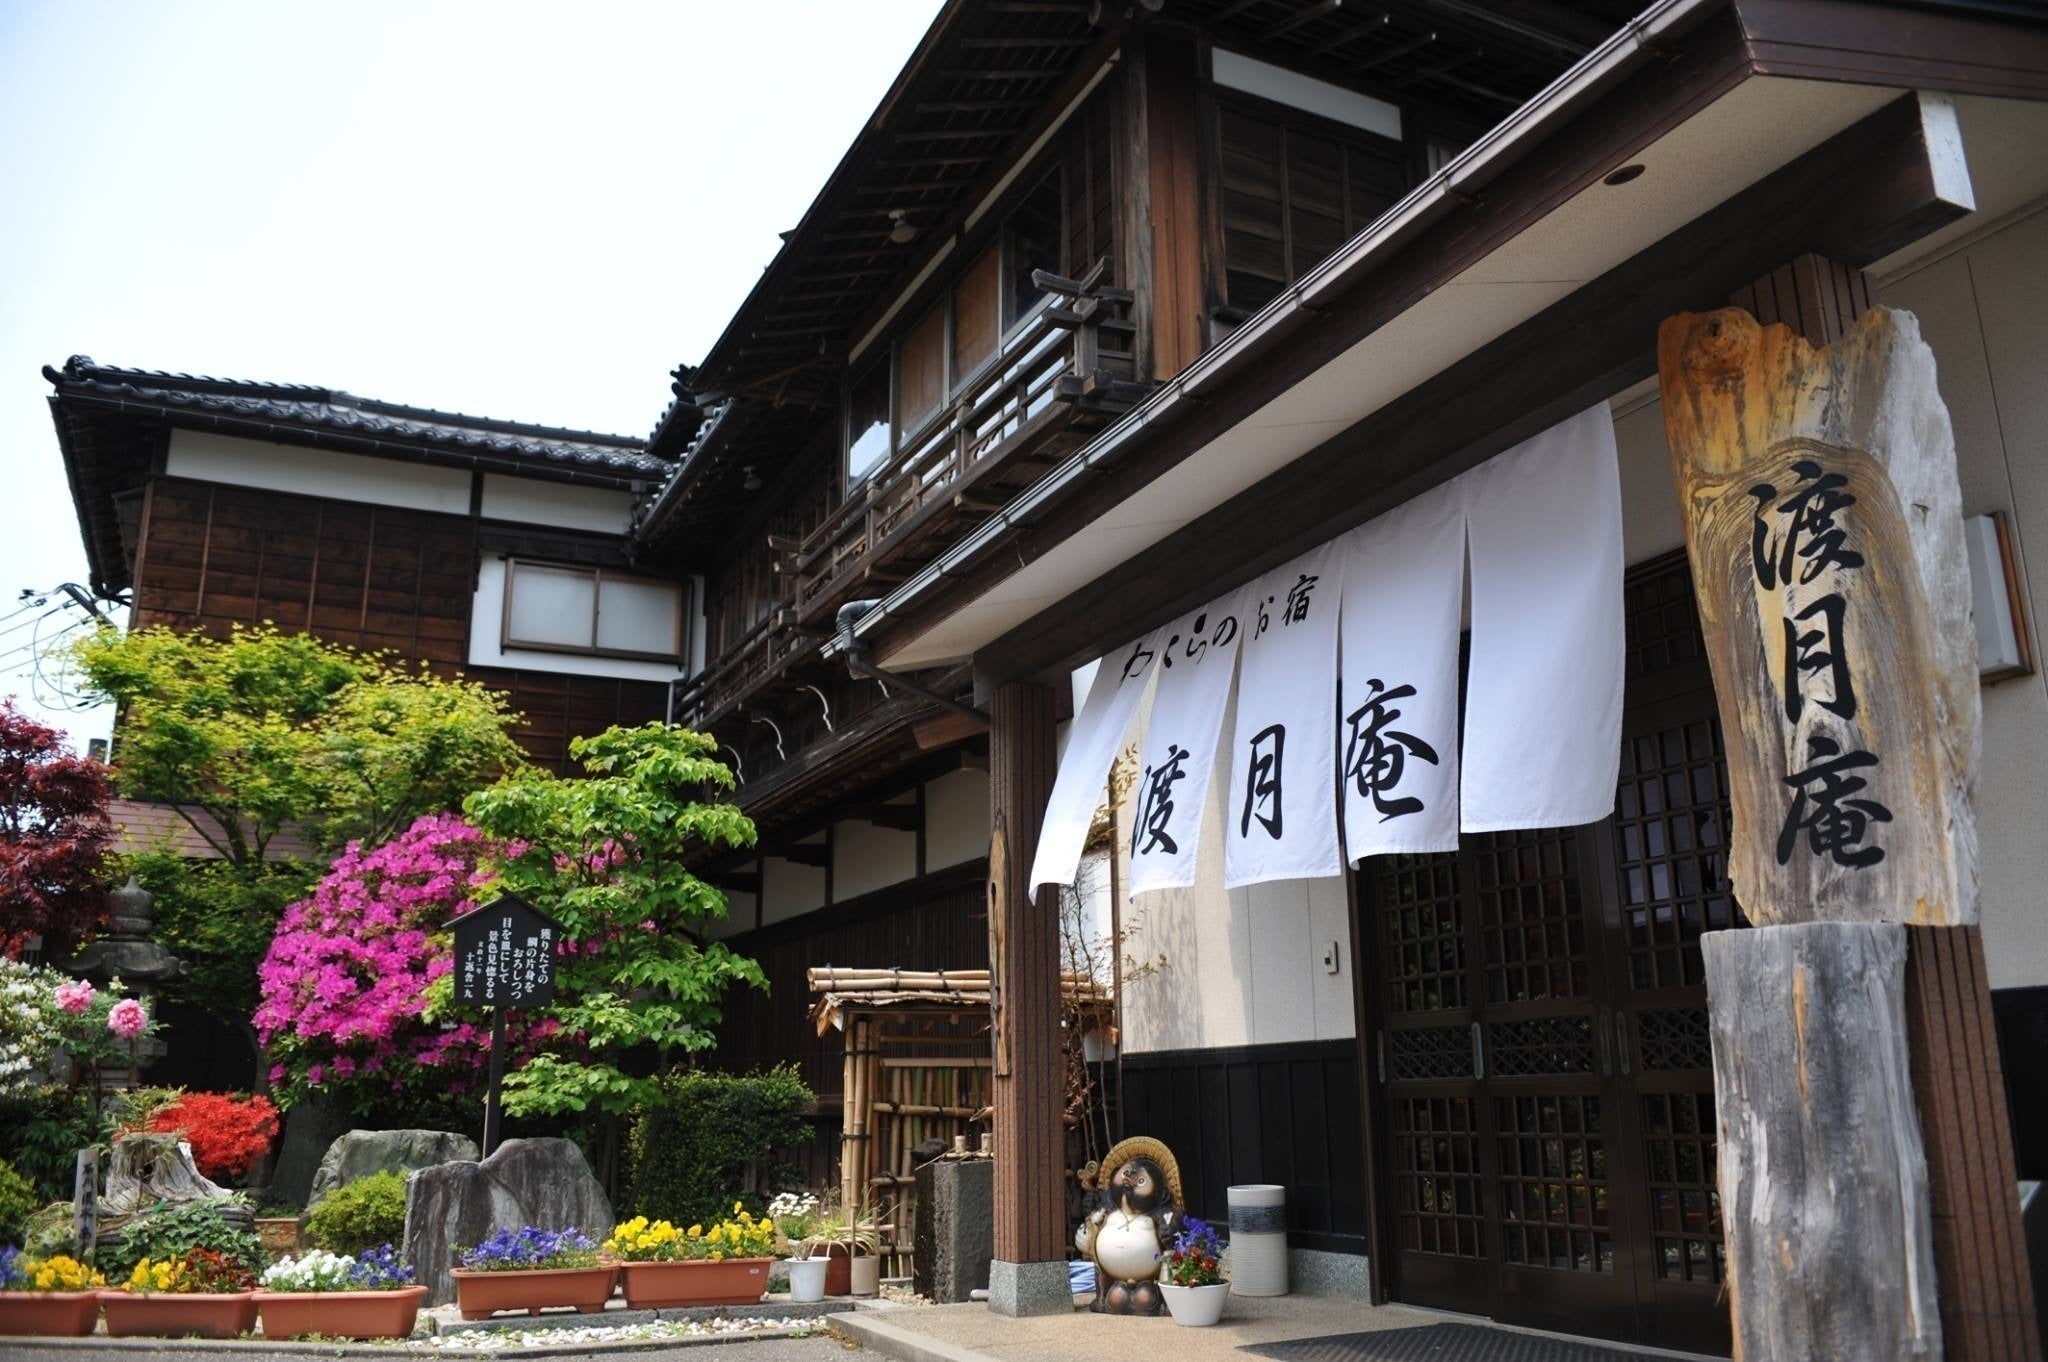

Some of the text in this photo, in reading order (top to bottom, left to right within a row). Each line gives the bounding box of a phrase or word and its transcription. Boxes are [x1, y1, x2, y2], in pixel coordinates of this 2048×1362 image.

[1119, 573, 1319, 686] わくらのお宿
[1747, 461, 1893, 870] 渡月庵
[1131, 678, 1439, 860] 渡月庵
[463, 951, 475, 998] 十返舎一九
[498, 917, 512, 984] 目を皿にして
[510, 948, 524, 999] おろしつつ
